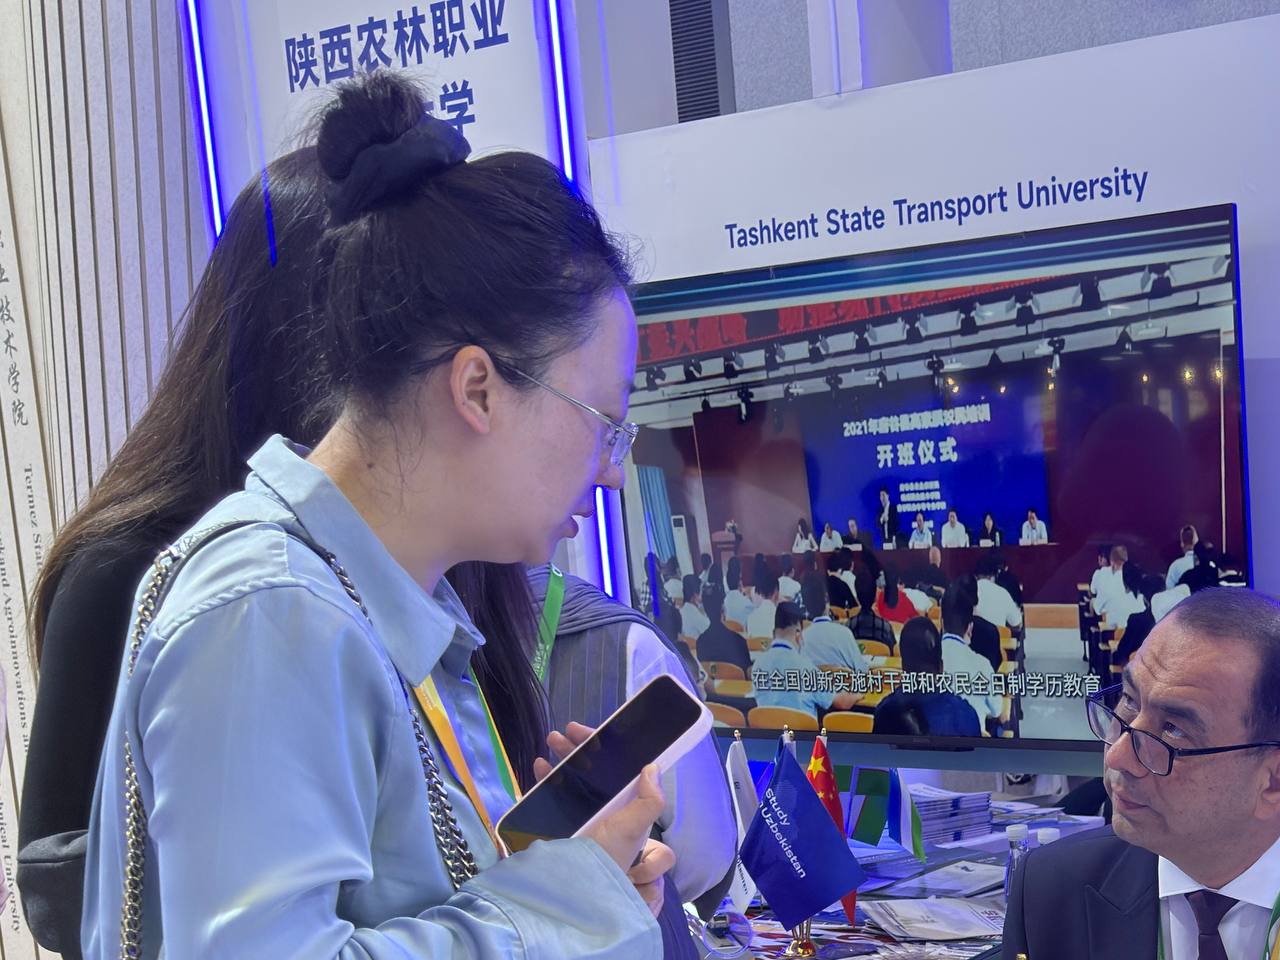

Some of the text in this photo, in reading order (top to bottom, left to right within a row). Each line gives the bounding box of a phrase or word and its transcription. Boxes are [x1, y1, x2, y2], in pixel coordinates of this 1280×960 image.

[284, 0, 509, 93] 陕西农林职业
[423, 80, 476, 134] 学
[725, 168, 1149, 249] Tashkent State Transport University
[877, 436, 958, 469] 开班仪式
[24, 464, 39, 529] Termez
[752, 669, 1101, 698] 在全国创新实施村干部和农民全日制学历教育
[761, 806, 807, 879] Uzbekistan
